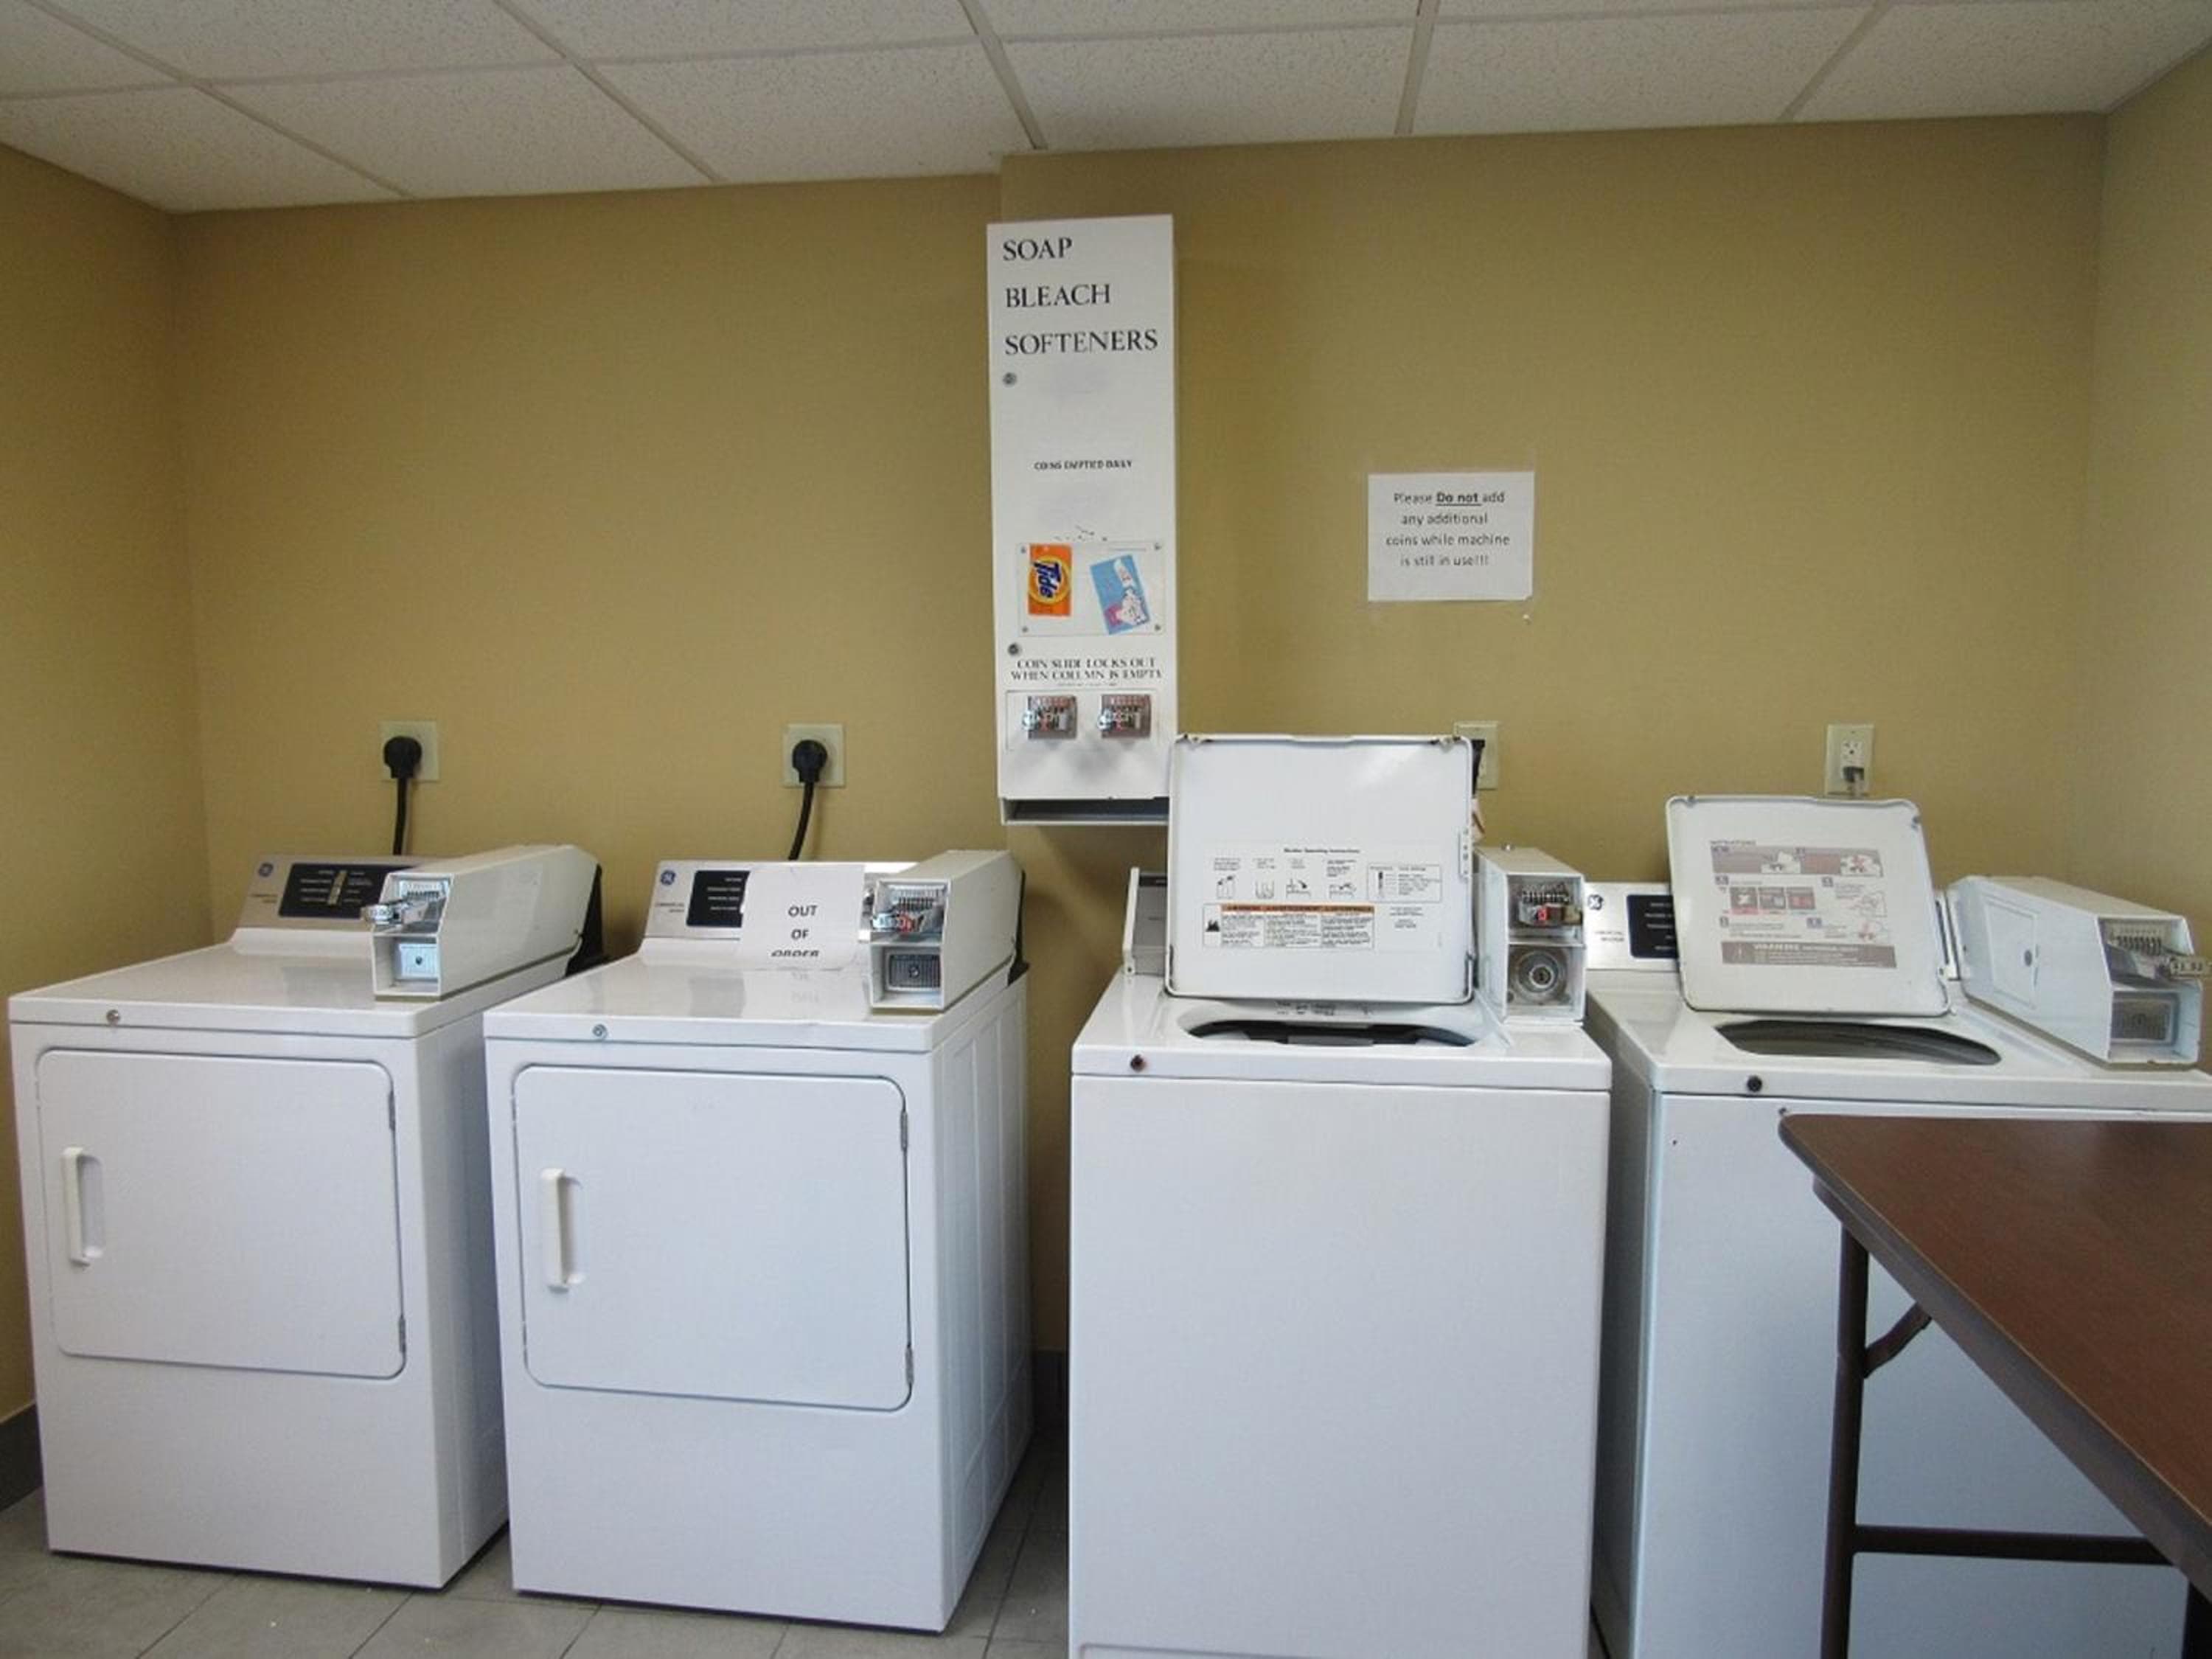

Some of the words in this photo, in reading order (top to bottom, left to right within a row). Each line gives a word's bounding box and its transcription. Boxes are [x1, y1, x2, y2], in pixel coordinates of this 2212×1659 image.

[1003, 237, 1072, 261] SOAP
[1006, 284, 1110, 308] BLEACH
[1005, 329, 1158, 355] SOFTENERS
[1034, 462, 1062, 470] COINS
[1394, 492, 1432, 504] Please
[1437, 492, 1453, 503] Do
[1457, 492, 1479, 503] not
[1482, 492, 1506, 503] add
[1401, 515, 1423, 526] any
[1427, 512, 1488, 525] additional
[1385, 535, 1418, 546] coins
[1421, 533, 1454, 546] while
[1458, 534, 1510, 546] machine
[1400, 556, 1411, 566] is
[1414, 555, 1435, 566] still
[1439, 555, 1451, 566] in
[1032, 560, 1062, 599] Tide
[1017, 658, 1048, 669] COIN
[1051, 658, 1080, 668] SLIDE
[1086, 658, 1127, 668] LOCKS
[1130, 657, 1155, 667] OUT
[1011, 670, 1048, 681] WHEN
[1109, 669, 1119, 679] IS
[1122, 669, 1161, 679] EMPTY
[788, 905, 818, 917] OUT
[791, 928, 810, 940] OF
